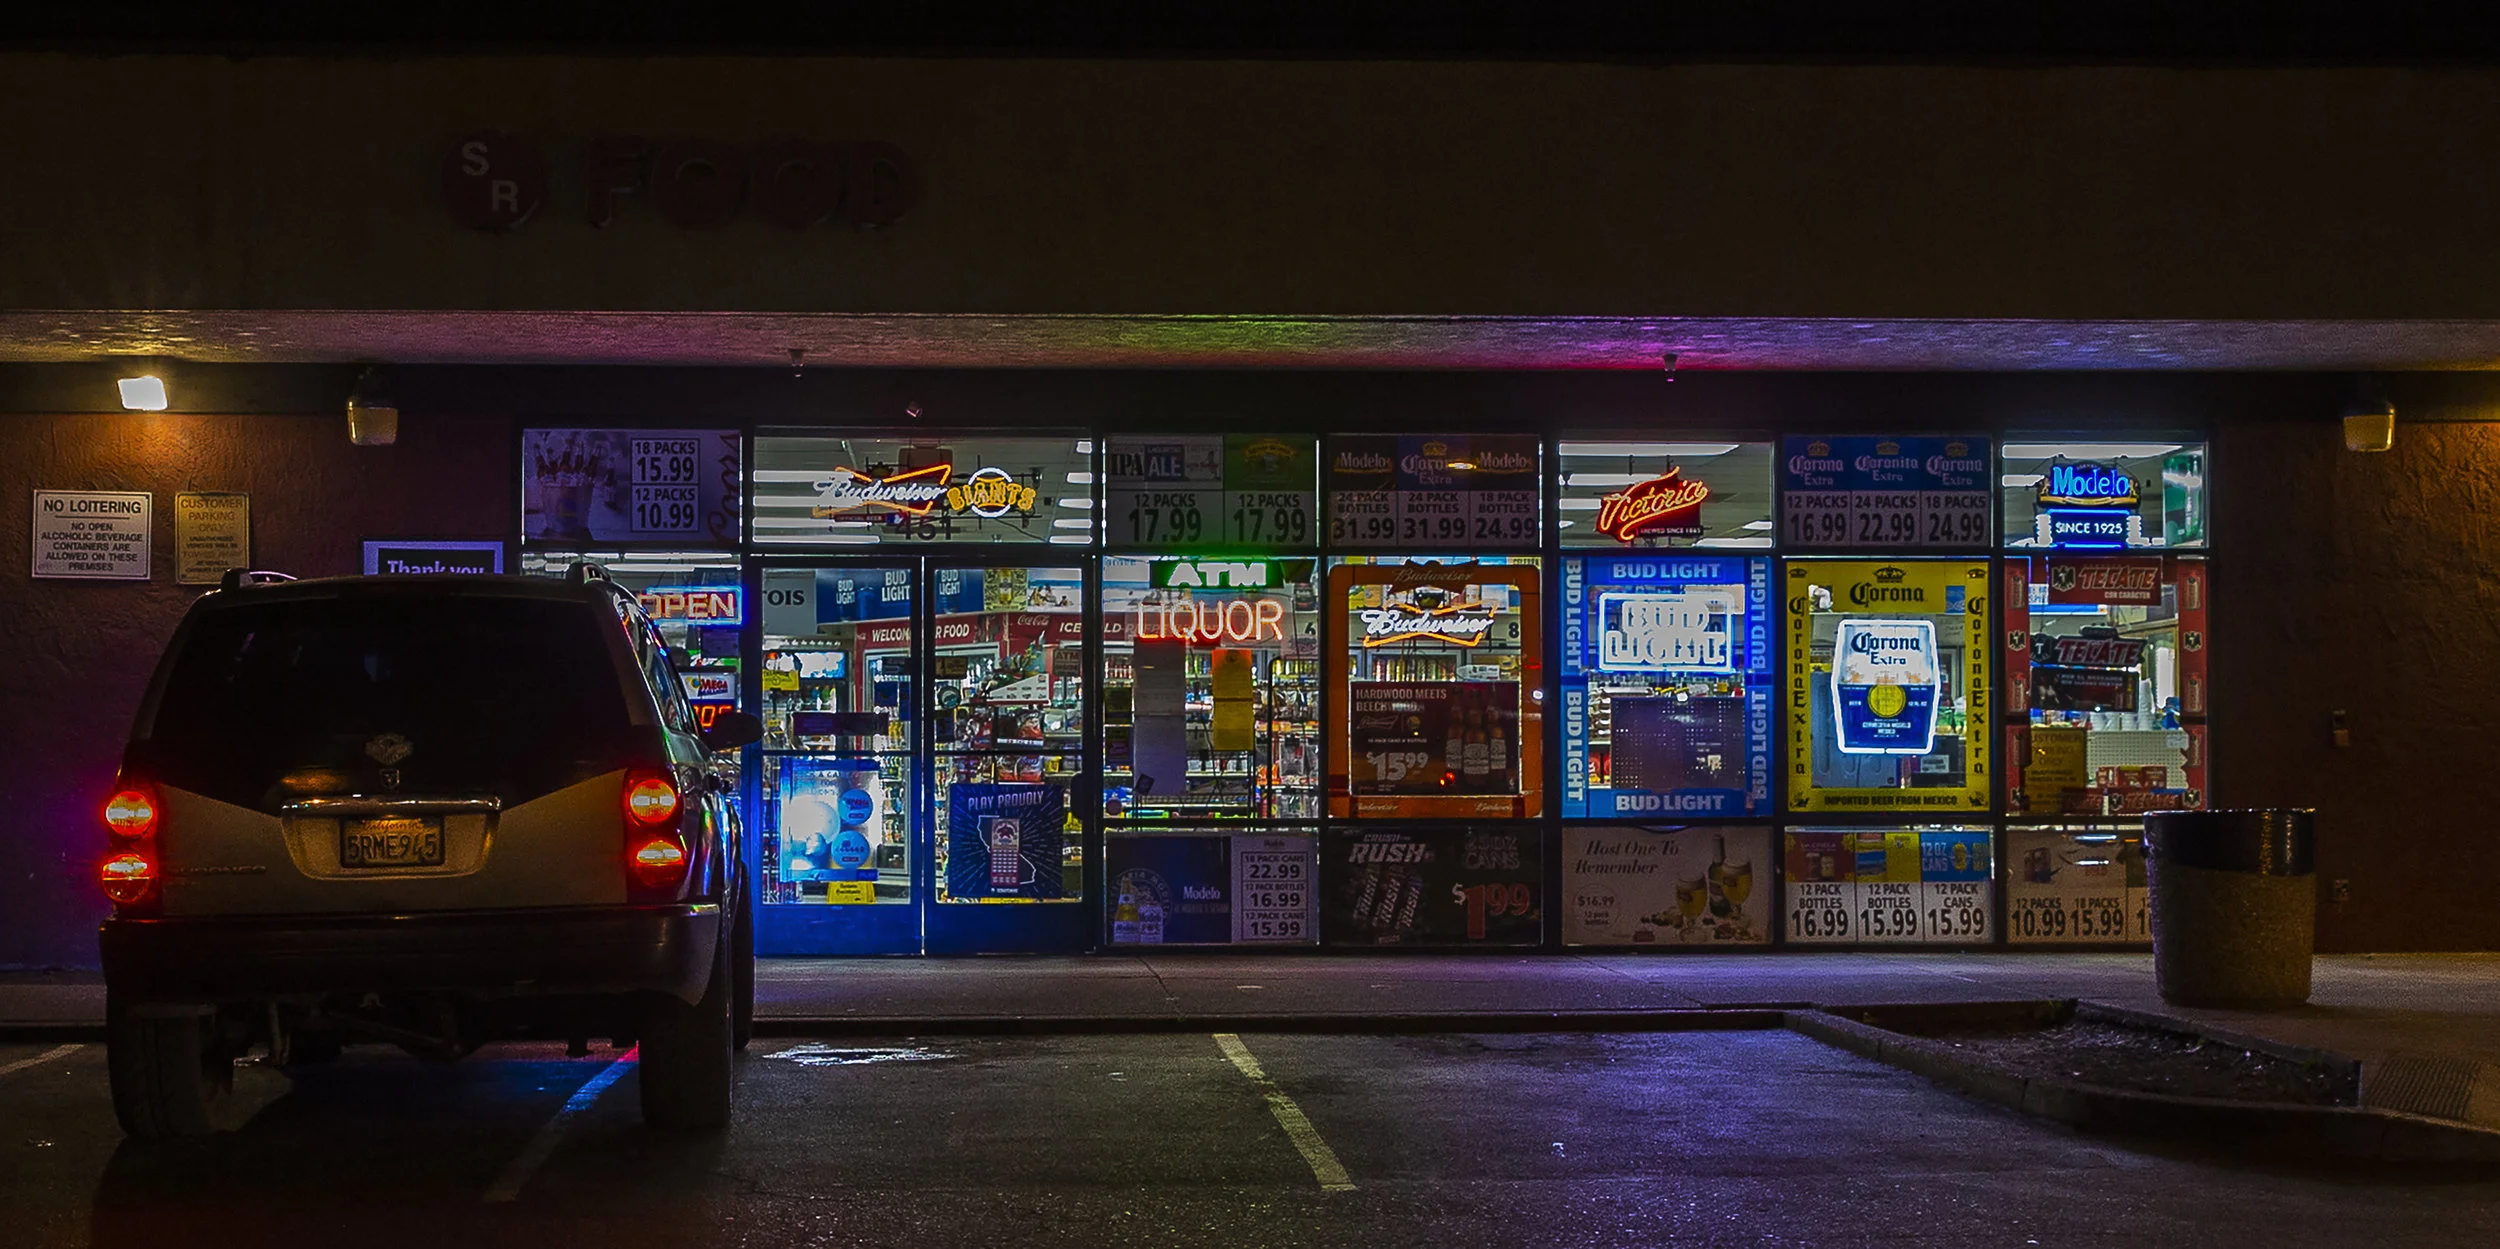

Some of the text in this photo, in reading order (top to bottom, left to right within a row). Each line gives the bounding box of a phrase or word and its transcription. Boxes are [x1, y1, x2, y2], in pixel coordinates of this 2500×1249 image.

[462, 141, 518, 213] S R
[584, 135, 921, 230] FOOD
[636, 442, 695, 454] 18 PACKS
[1109, 454, 1143, 476] IPA
[1150, 456, 1181, 476] ALE
[1341, 452, 1385, 468] Modelo
[1480, 452, 1528, 468] Modelo
[1789, 455, 1844, 476] Corona
[1854, 455, 1919, 473] Coronita
[1926, 455, 1983, 476] Corona
[637, 457, 694, 481] 15.99
[1872, 470, 1903, 482] Extra
[1419, 474, 1452, 484] Extra
[1803, 474, 1833, 486] Extra
[1942, 473, 1973, 486] Extra
[2053, 467, 2129, 495] Modelo
[636, 488, 695, 500] 12 PACKS
[813, 479, 947, 501] Budweiser
[947, 482, 1036, 511] GIANTS
[1358, 493, 1388, 502] PACK
[1409, 493, 1458, 502] 24 PACK
[1480, 493, 1529, 502] 18 PACK
[181, 499, 243, 508] CUSTOMER
[1135, 494, 1195, 507] 12 PACKS
[1240, 494, 1299, 507] 12 PACKS
[1601, 466, 1708, 531] Victoria
[1788, 496, 1848, 508] 12 PACKS
[1856, 496, 1916, 508] 24 PACKS
[1927, 496, 1986, 508] 18 PACKS
[44, 500, 141, 513] NO LOITERING
[1338, 504, 1389, 513] BOTTLES
[1408, 504, 1459, 513] BOTTLES
[1479, 504, 1530, 513] BOTTLES
[189, 512, 235, 520] PARKING
[637, 503, 694, 528] 10.99
[1129, 509, 1201, 543] 17.99
[1234, 509, 1305, 543] 17.99
[1333, 519, 1394, 539] 31.99
[1404, 519, 1465, 539] 31.99
[1475, 519, 1536, 539] 24.99
[1791, 513, 1846, 542] 16.99
[1859, 513, 1914, 542] 22.99
[1929, 513, 1984, 542] 24.99
[2056, 522, 2123, 534] SINCE 1925
[42, 532, 92, 540] ALCOHOLIC
[53, 542, 130, 551] CONTAINERS ARE
[46, 552, 88, 560] ALLOWED
[109, 553, 137, 561] THESE
[69, 562, 113, 570] PREMISES
[388, 560, 445, 573] Thank
[1613, 563, 1721, 579] BUD LIGHT
[886, 572, 907, 585] BUD
[1167, 562, 1266, 586] ATM
[1392, 567, 1474, 581] Budweiser
[2079, 566, 2159, 590] TECATE
[838, 580, 854, 591] BUD
[836, 592, 856, 604] LIGHT
[882, 586, 910, 601] LIGHT
[1850, 582, 1924, 607] Corona
[638, 594, 735, 618] OPEN
[1138, 600, 1283, 642] LIQUOR
[1361, 609, 1494, 634] Budweiser
[1566, 559, 1583, 671] BUD LIGHT
[1750, 560, 1766, 669] BUD LIGHT
[943, 624, 970, 638] FOOD
[1060, 622, 1082, 633] ICE
[1305, 622, 1315, 635] 6
[1509, 622, 1519, 638] 8
[1851, 632, 1922, 655] Corona
[1870, 652, 1906, 665] Extra
[2055, 639, 2144, 665] TECATE
[1356, 689, 1447, 699] HARDWOOD MEETS
[1567, 691, 1583, 801] BUD LIGHT
[1751, 691, 1767, 800] BUD LIGHT
[968, 791, 1044, 810] PLAY PROUDLY
[1616, 794, 1724, 811] BUD LIGHT
[1923, 796, 1957, 805] MEXICO
[1363, 834, 1400, 843] CRUSH
[348, 834, 436, 859] 5RME945
[1348, 843, 1427, 863] RUSH
[1586, 840, 1680, 856] Host One To
[1250, 865, 1300, 879] 22.99
[1575, 859, 1659, 874] Remember
[1183, 885, 1220, 900] Modelo
[1801, 884, 1841, 894] 12 PACK
[1868, 884, 1910, 894] 12 PACK
[1935, 884, 1978, 894] 12 PACK
[1251, 893, 1300, 907] 16.99
[1578, 896, 1615, 906] $16.99
[1800, 898, 1842, 908] BOTTLES
[1868, 898, 1911, 908] BOTTLES
[1944, 898, 1973, 908] CANS
[2017, 898, 2061, 908] 12 PACKS
[2089, 898, 2119, 908] PACKS
[1251, 922, 1300, 936] 15.99
[1792, 909, 1848, 936] 16.99
[1860, 909, 1917, 936] 15.99
[1928, 908, 1985, 936] 15.99
[2012, 909, 2066, 936] 10.99
[2070, 909, 2123, 936] 15.99
